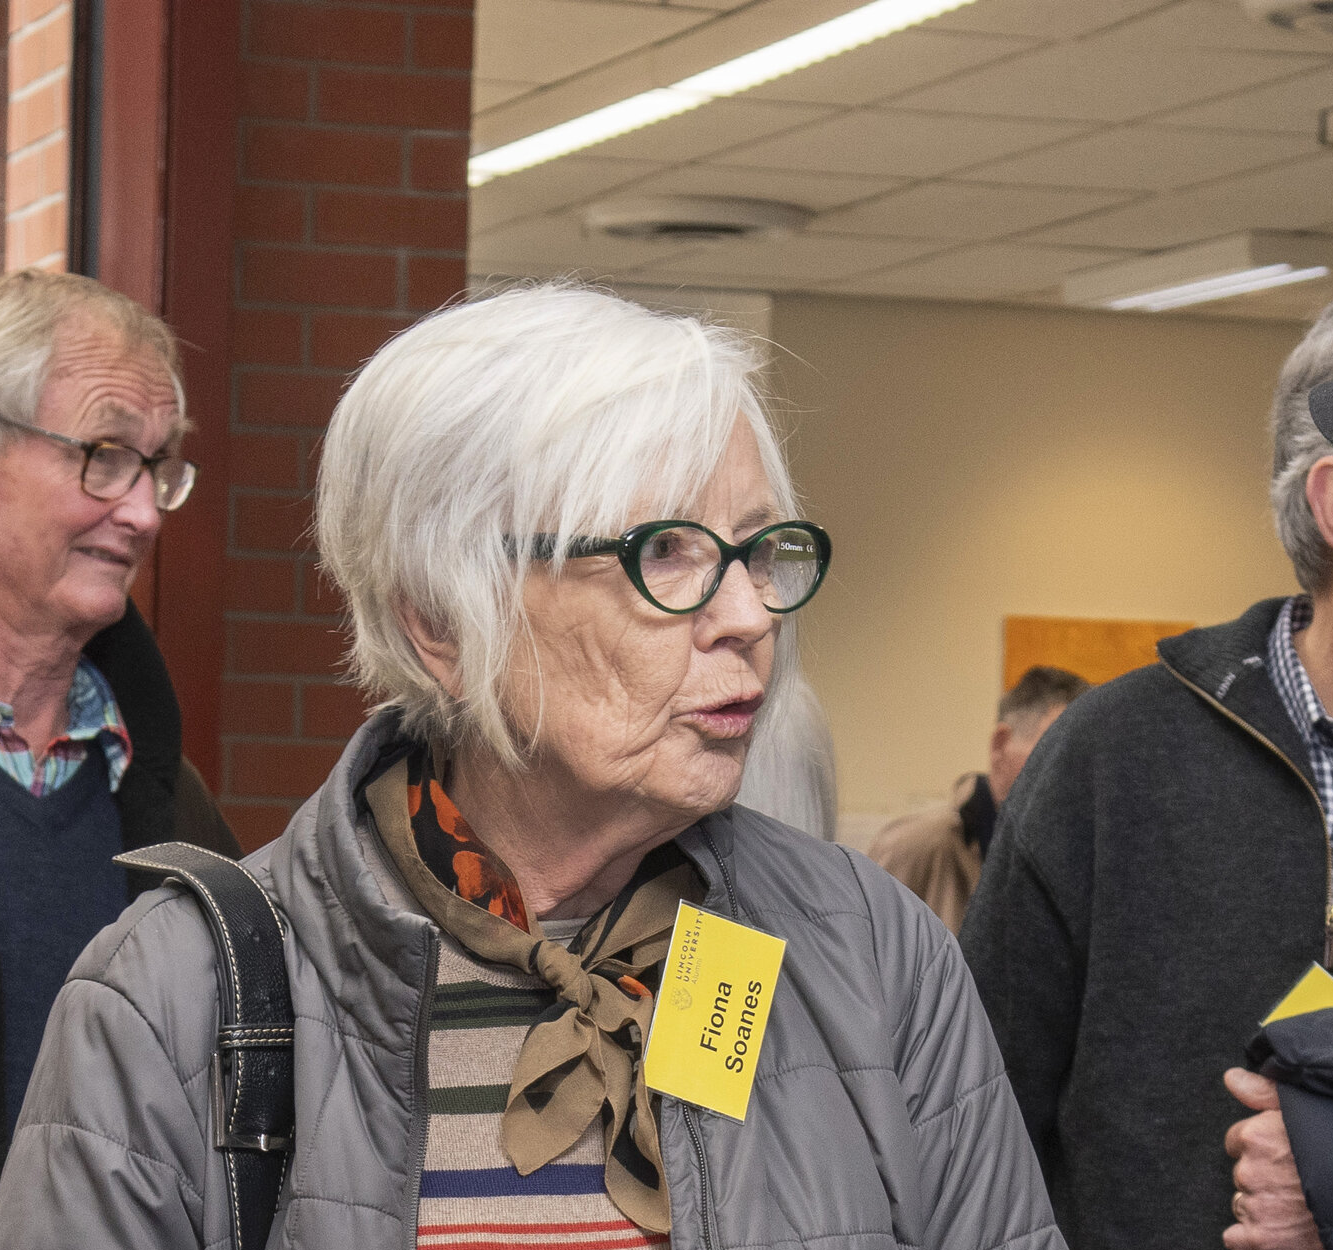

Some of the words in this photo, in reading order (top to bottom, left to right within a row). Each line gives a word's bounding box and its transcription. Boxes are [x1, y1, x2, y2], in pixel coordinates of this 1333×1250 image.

[676, 930, 692, 980] LINCOLN
[683, 910, 704, 982] UNIVERSITY
[692, 958, 703, 984] Alumni
[700, 981, 733, 1052] Fiona
[725, 980, 762, 1073] Soanes
